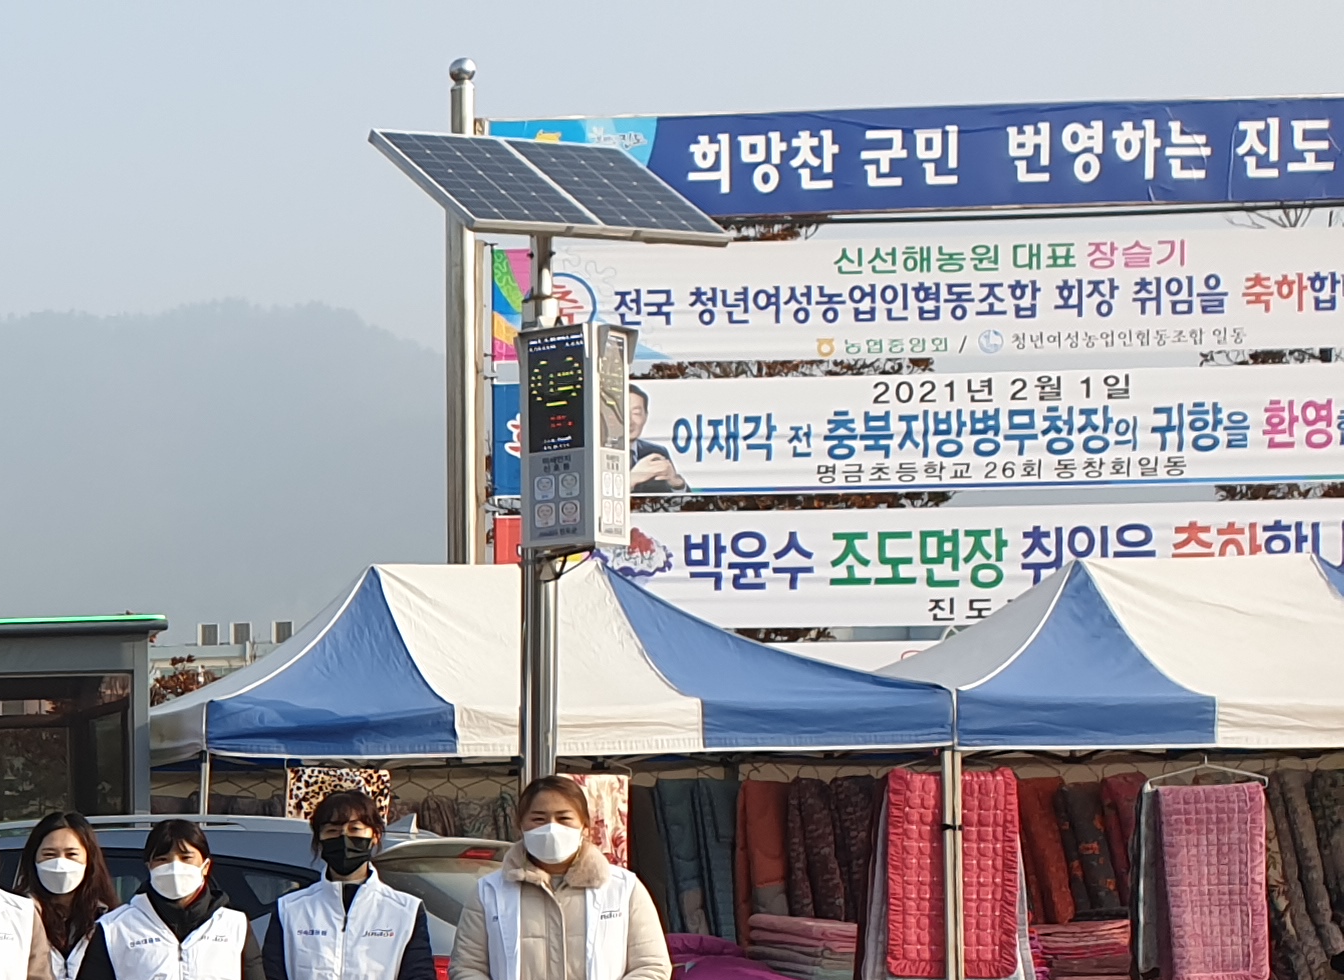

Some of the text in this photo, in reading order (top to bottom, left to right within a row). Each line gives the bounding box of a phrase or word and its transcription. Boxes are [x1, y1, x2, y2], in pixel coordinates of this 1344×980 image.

[687, 118, 1334, 195] 희망찬 군민 번영하는 진도
[834, 240, 1185, 274] 신선해농원 대표 장슬기
[613, 272, 1344, 326] 전국 청년여성농업인협동조합 회장 취임을 축하합
[845, 338, 947, 358] 농협중앙회
[1013, 328, 1203, 349] 청년여성농업인협동조합
[1212, 327, 1248, 345] 일동
[873, 374, 1129, 404] 2021년 2월 1일
[673, 399, 1344, 462] 이재각 전 충북지방병무청장의 귀향을 환영
[817, 453, 1190, 487] 명금초등학교 26회 동창회일동
[683, 529, 815, 591] 박윤수
[830, 528, 1007, 588] 조도면장
